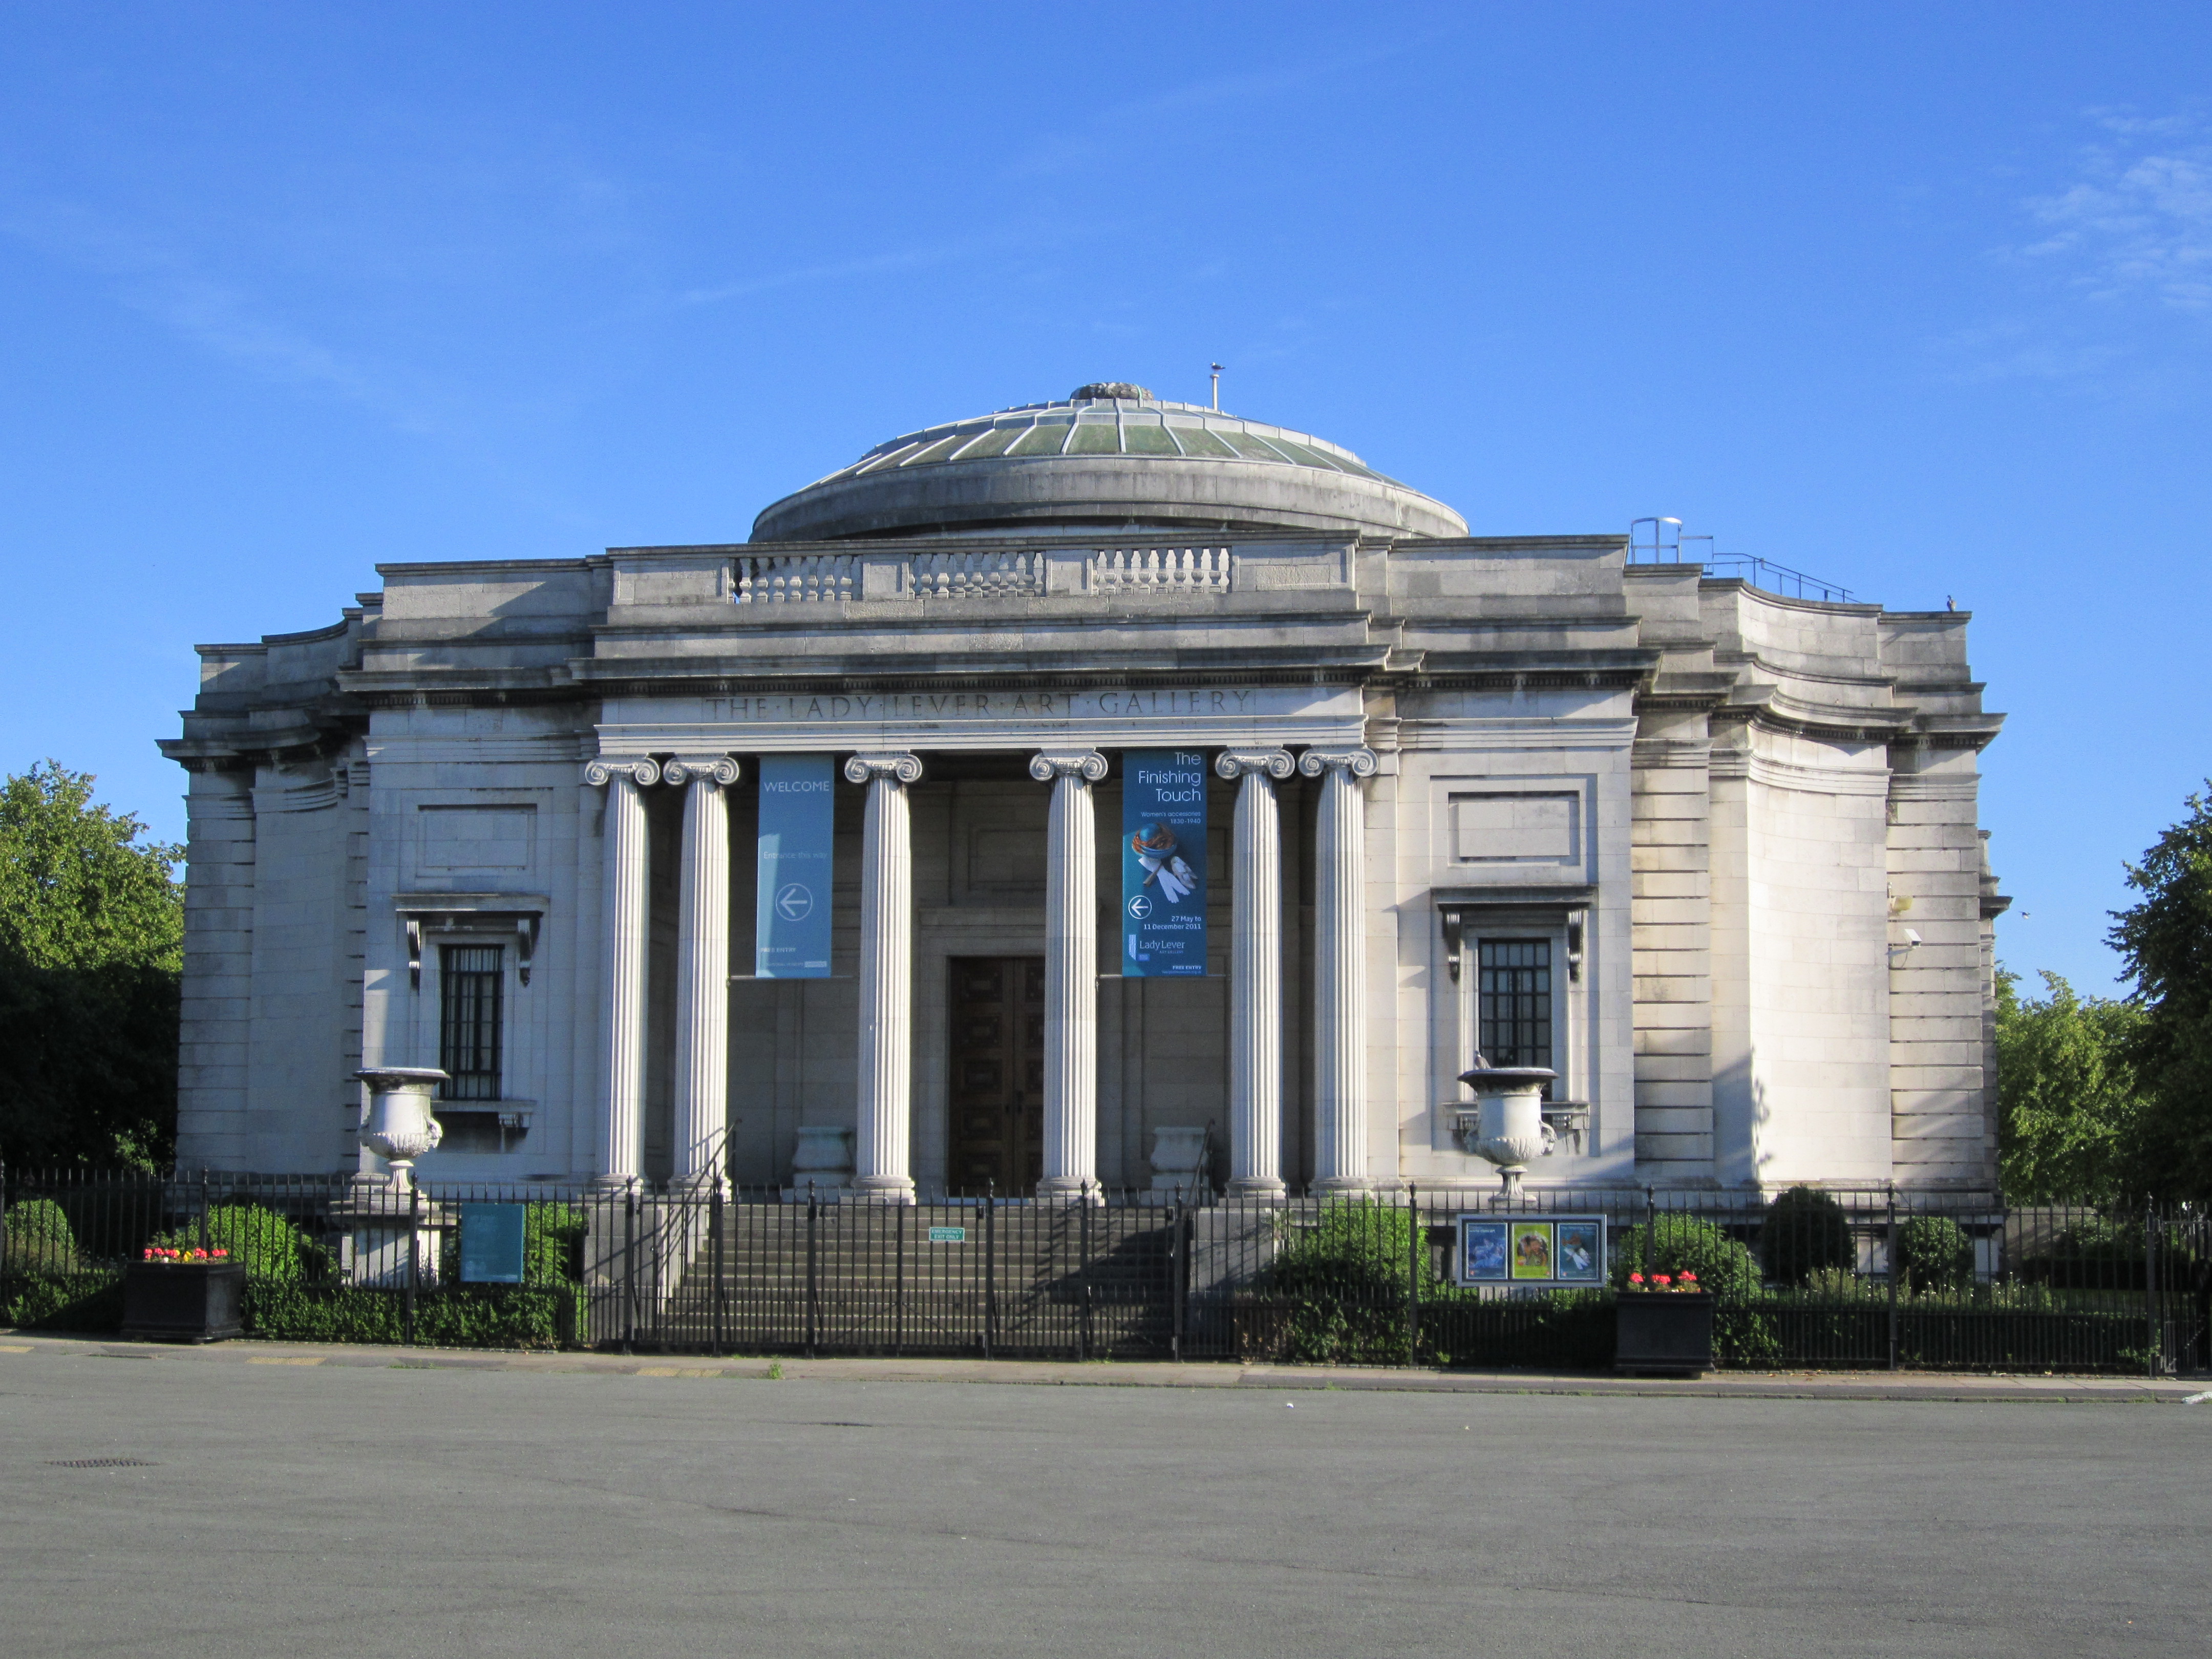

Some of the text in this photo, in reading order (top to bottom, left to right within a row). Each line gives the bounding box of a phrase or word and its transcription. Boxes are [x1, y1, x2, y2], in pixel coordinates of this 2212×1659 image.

[706, 690, 1250, 718] THE LADY LEVER ART GALLERY
[1175, 752, 1201, 765] The
[1139, 770, 1201, 786] Finishing
[763, 781, 830, 792] WELCOME
[1156, 788, 1201, 802] Touch
[763, 851, 796, 859] Entrance
[1139, 941, 1185, 950] Lady Lever
